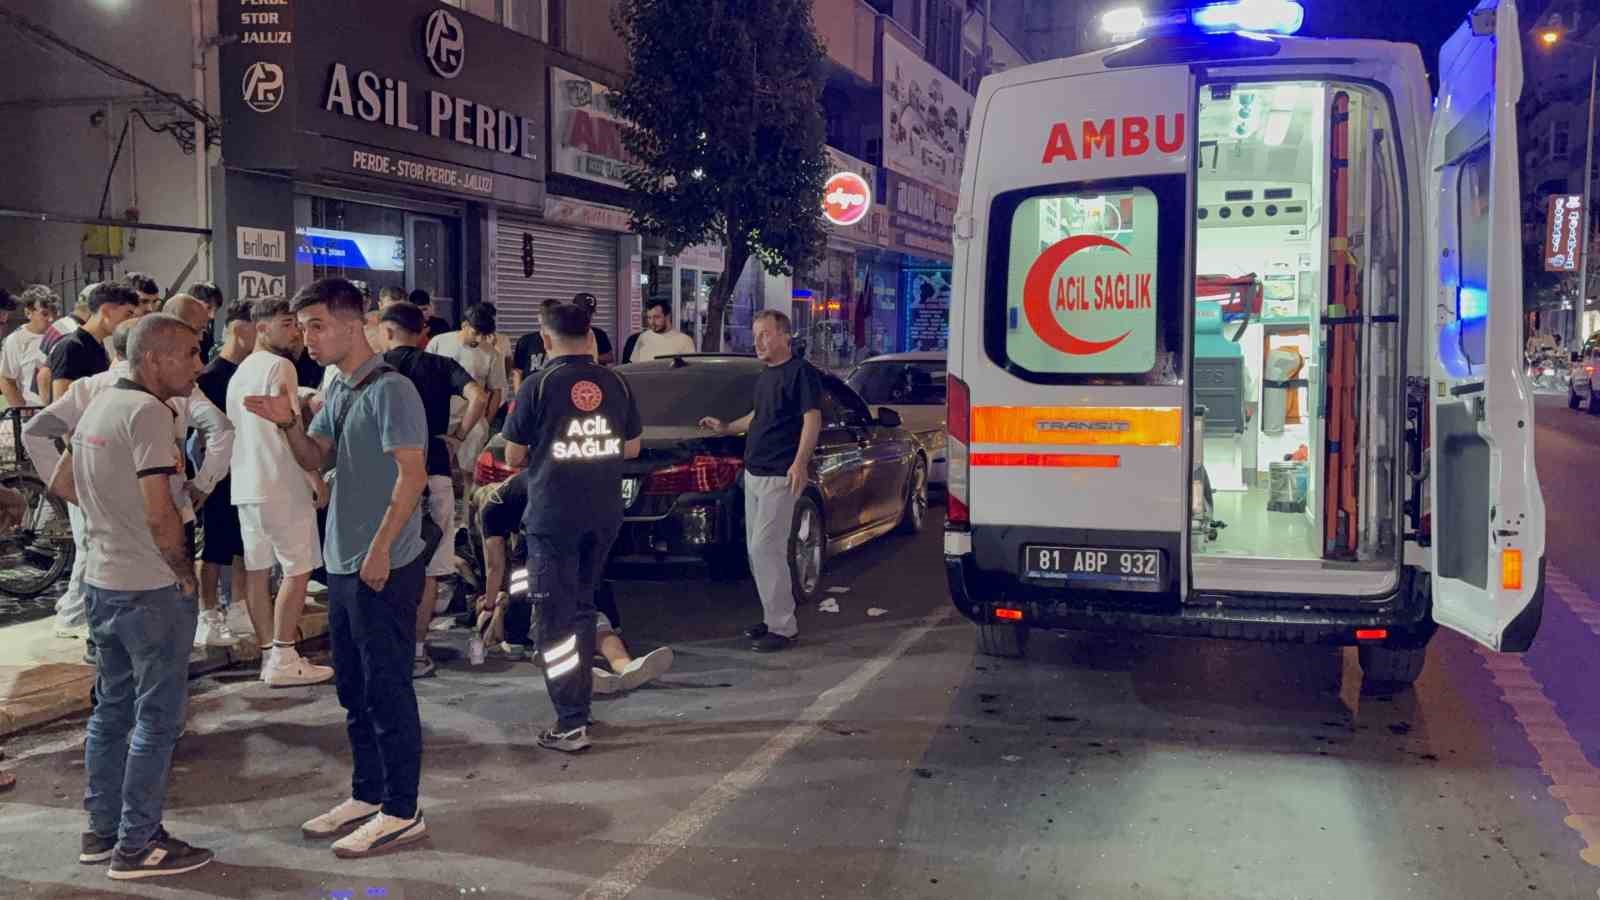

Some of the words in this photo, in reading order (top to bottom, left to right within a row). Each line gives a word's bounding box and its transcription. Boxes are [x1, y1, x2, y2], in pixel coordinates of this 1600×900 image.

[241, 12, 279, 24] STOR
[431, 90, 537, 160] PERDE
[1041, 113, 1185, 164] AMBU
[352, 151, 390, 172] PERDE
[397, 160, 425, 179] STOR
[425, 166, 457, 185] PERDE
[243, 231, 281, 258] brillant
[552, 438, 621, 459] SAĞLIK
[1040, 550, 1060, 570] 81
[1073, 551, 1108, 572] ABP
[1120, 553, 1156, 574] 932
